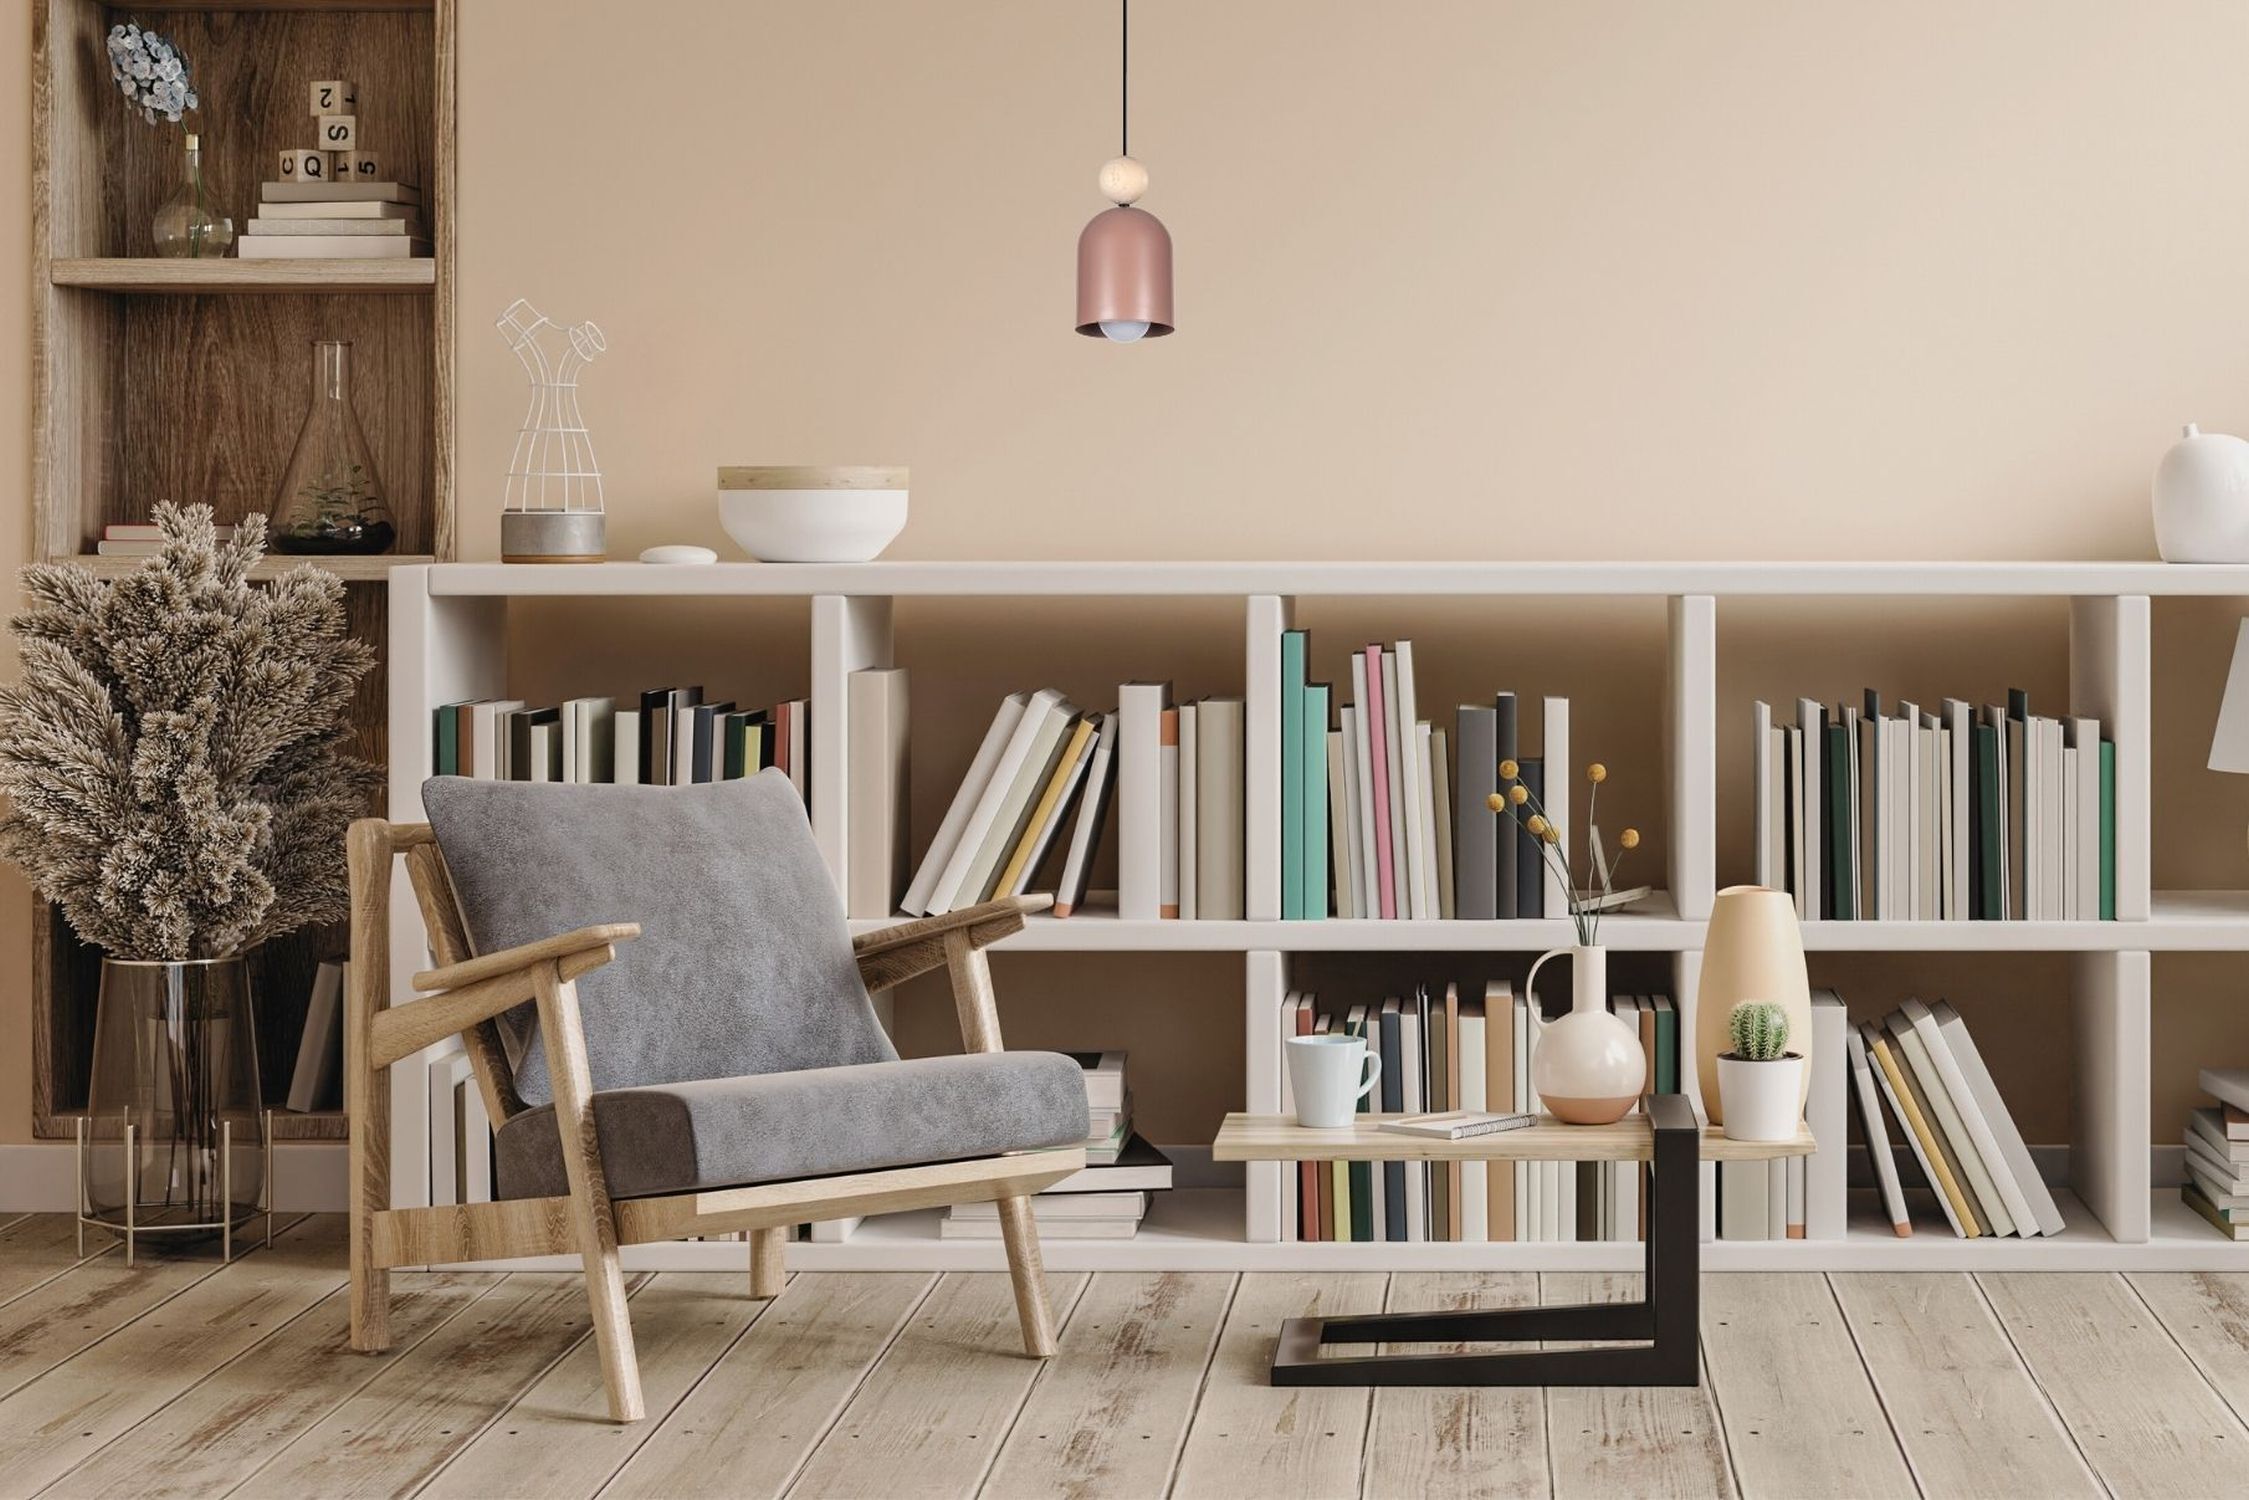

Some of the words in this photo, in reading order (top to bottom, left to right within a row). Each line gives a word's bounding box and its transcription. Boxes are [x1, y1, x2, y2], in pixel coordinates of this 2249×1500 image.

[320, 88, 332, 108] 2
[327, 125, 349, 141] S
[304, 156, 322, 178] Q
[358, 161, 376, 175] 5
